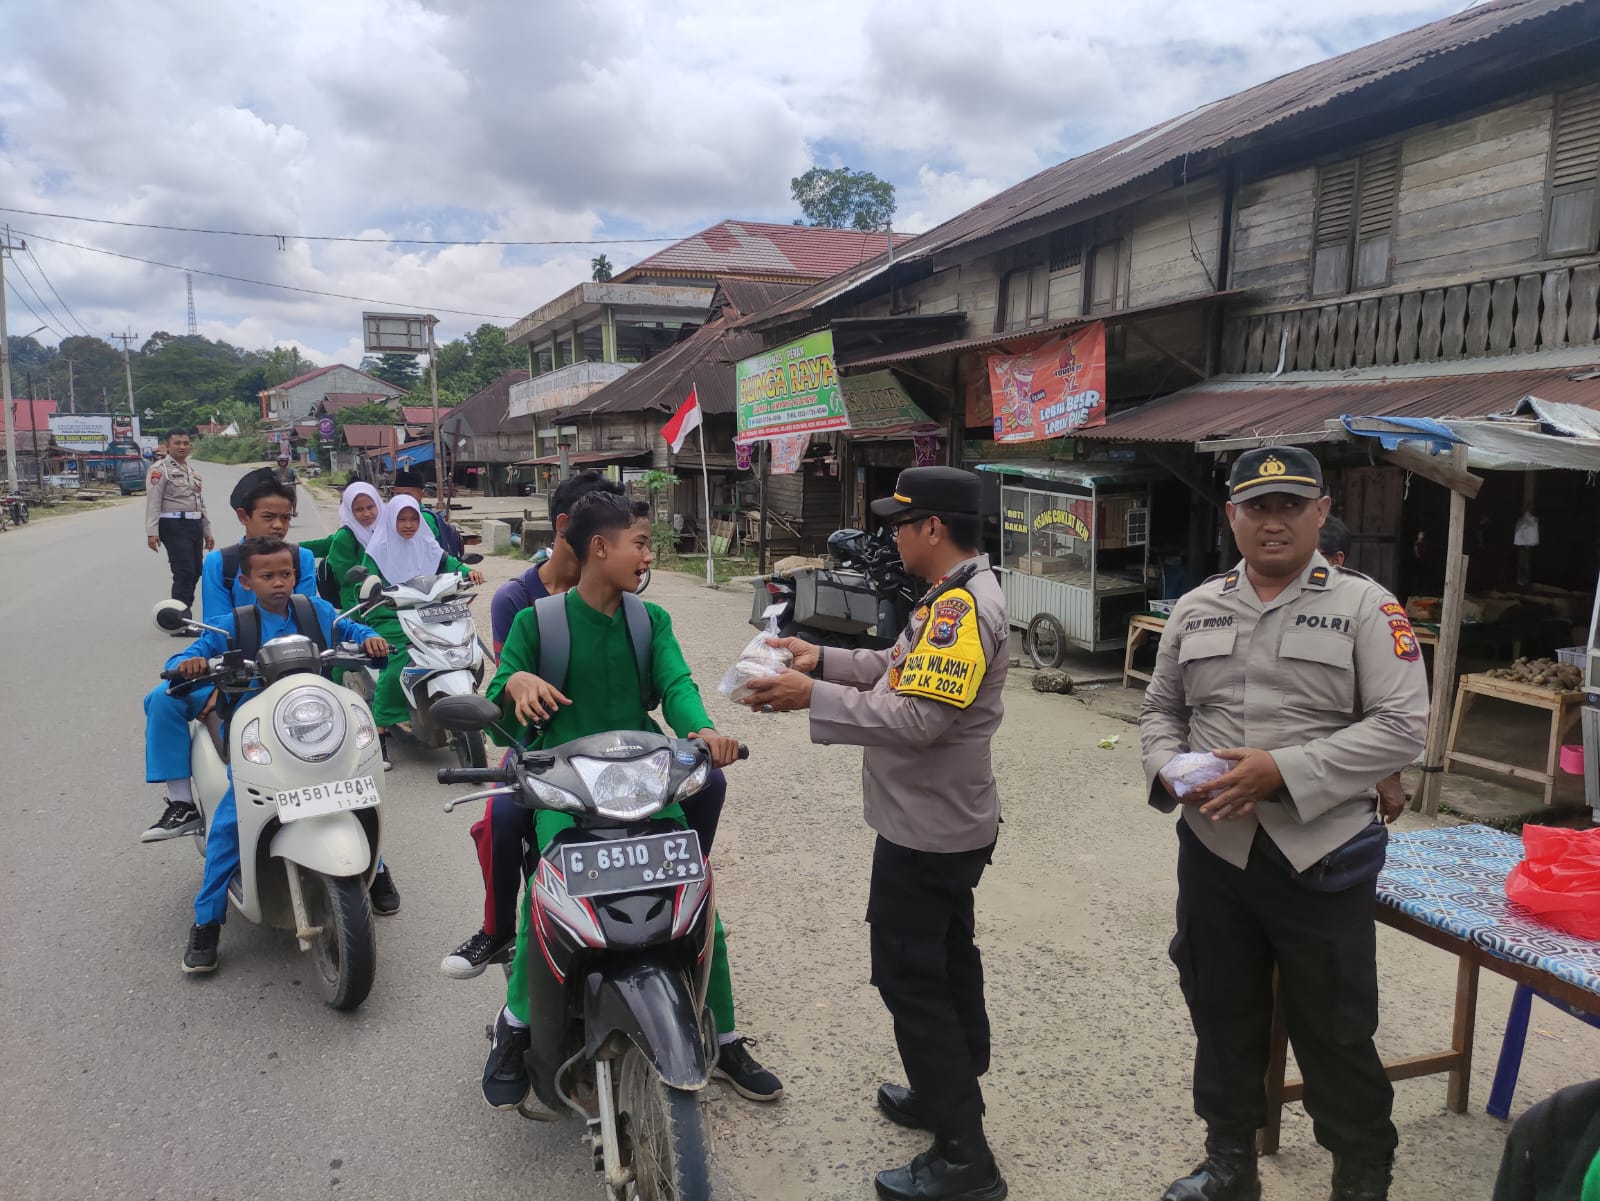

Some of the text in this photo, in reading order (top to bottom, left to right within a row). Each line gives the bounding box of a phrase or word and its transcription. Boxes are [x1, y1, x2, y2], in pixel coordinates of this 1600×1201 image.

[740, 354, 837, 406] BUNGA RAYA
[1004, 521, 1028, 534] BAKAR
[1034, 510, 1053, 532] PISANG
[1075, 517, 1091, 543] KEJU
[1186, 616, 1233, 631] PUJI WIDODO
[1296, 614, 1350, 633] POLRI
[927, 655, 970, 680] WILAYAH
[918, 675, 932, 688] LK
[935, 677, 965, 696] 2024
[606, 745, 644, 753] HONDA
[278, 777, 375, 806] BM 5814 BAH
[570, 838, 690, 873] G 6510 CZ
